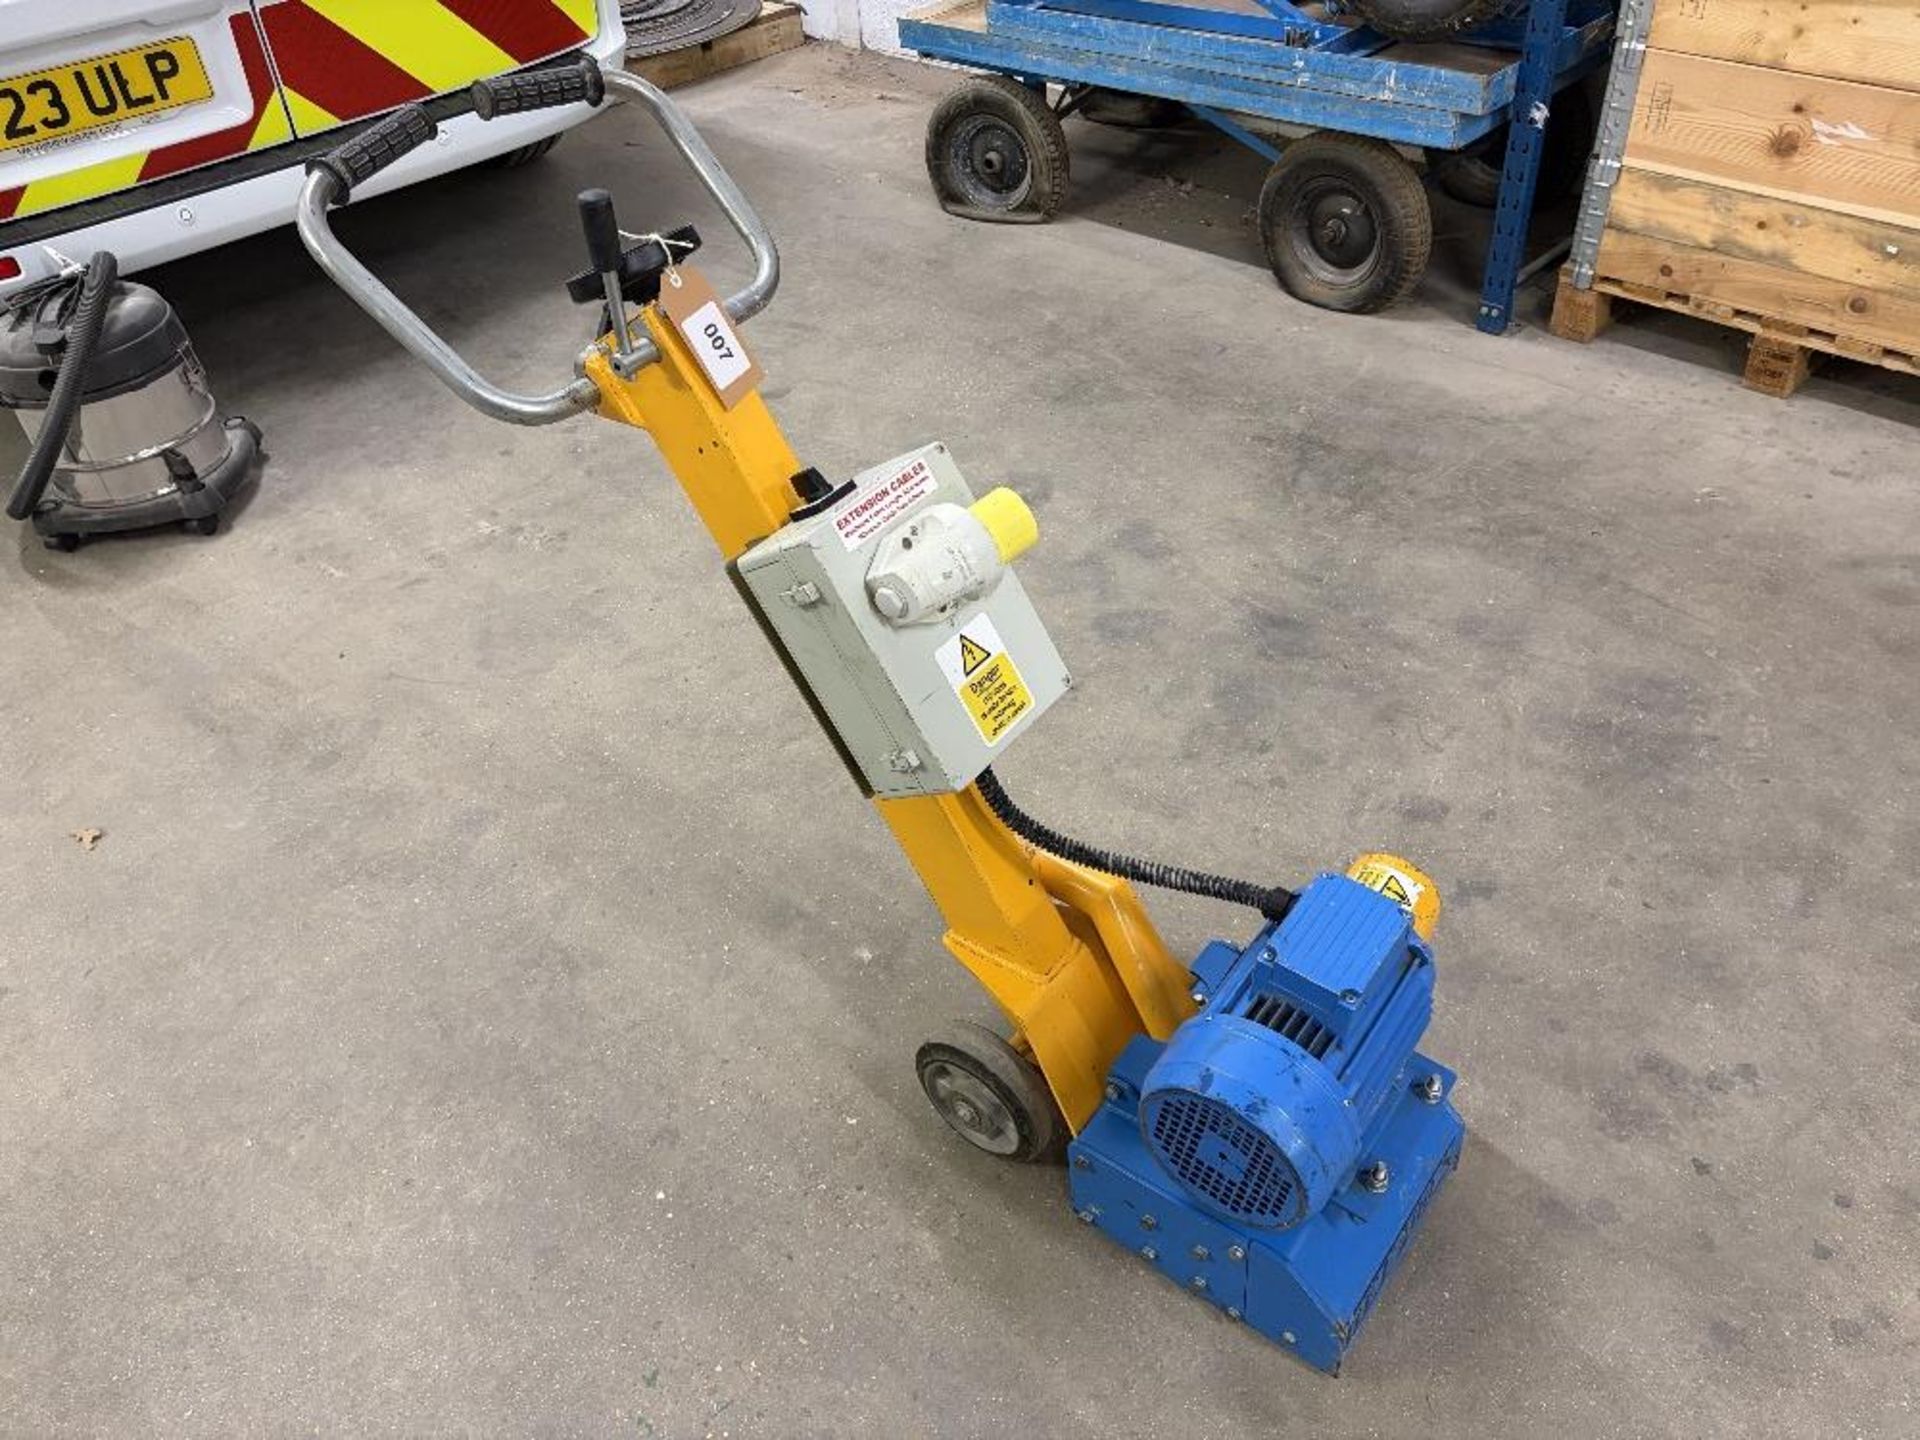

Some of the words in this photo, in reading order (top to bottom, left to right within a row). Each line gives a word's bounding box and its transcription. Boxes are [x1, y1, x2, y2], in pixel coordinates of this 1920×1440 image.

[0, 79, 70, 140] 23
[74, 50, 180, 116] ULP
[704, 323, 734, 359] 007
[836, 487, 890, 531] EXTENSION
[890, 462, 925, 492] CABLES
[969, 663, 999, 694] Danger
